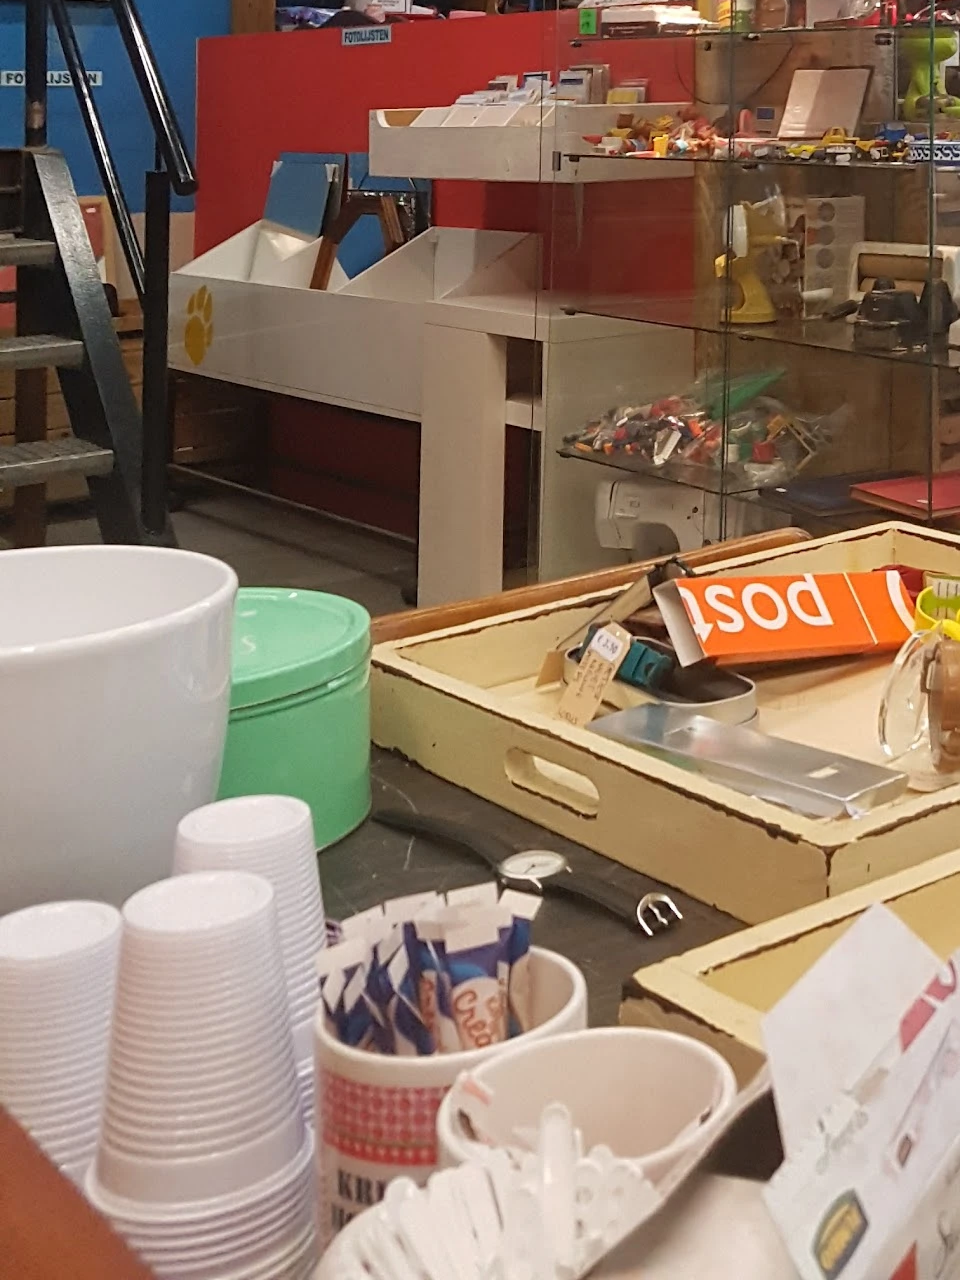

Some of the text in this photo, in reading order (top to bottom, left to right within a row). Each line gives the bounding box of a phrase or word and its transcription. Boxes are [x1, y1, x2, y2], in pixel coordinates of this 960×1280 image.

[344, 29, 390, 43] FOTOLIJSTEN
[6, 73, 97, 84] FOIJSN
[678, 573, 834, 644] post
[451, 989, 493, 1049] Crea
